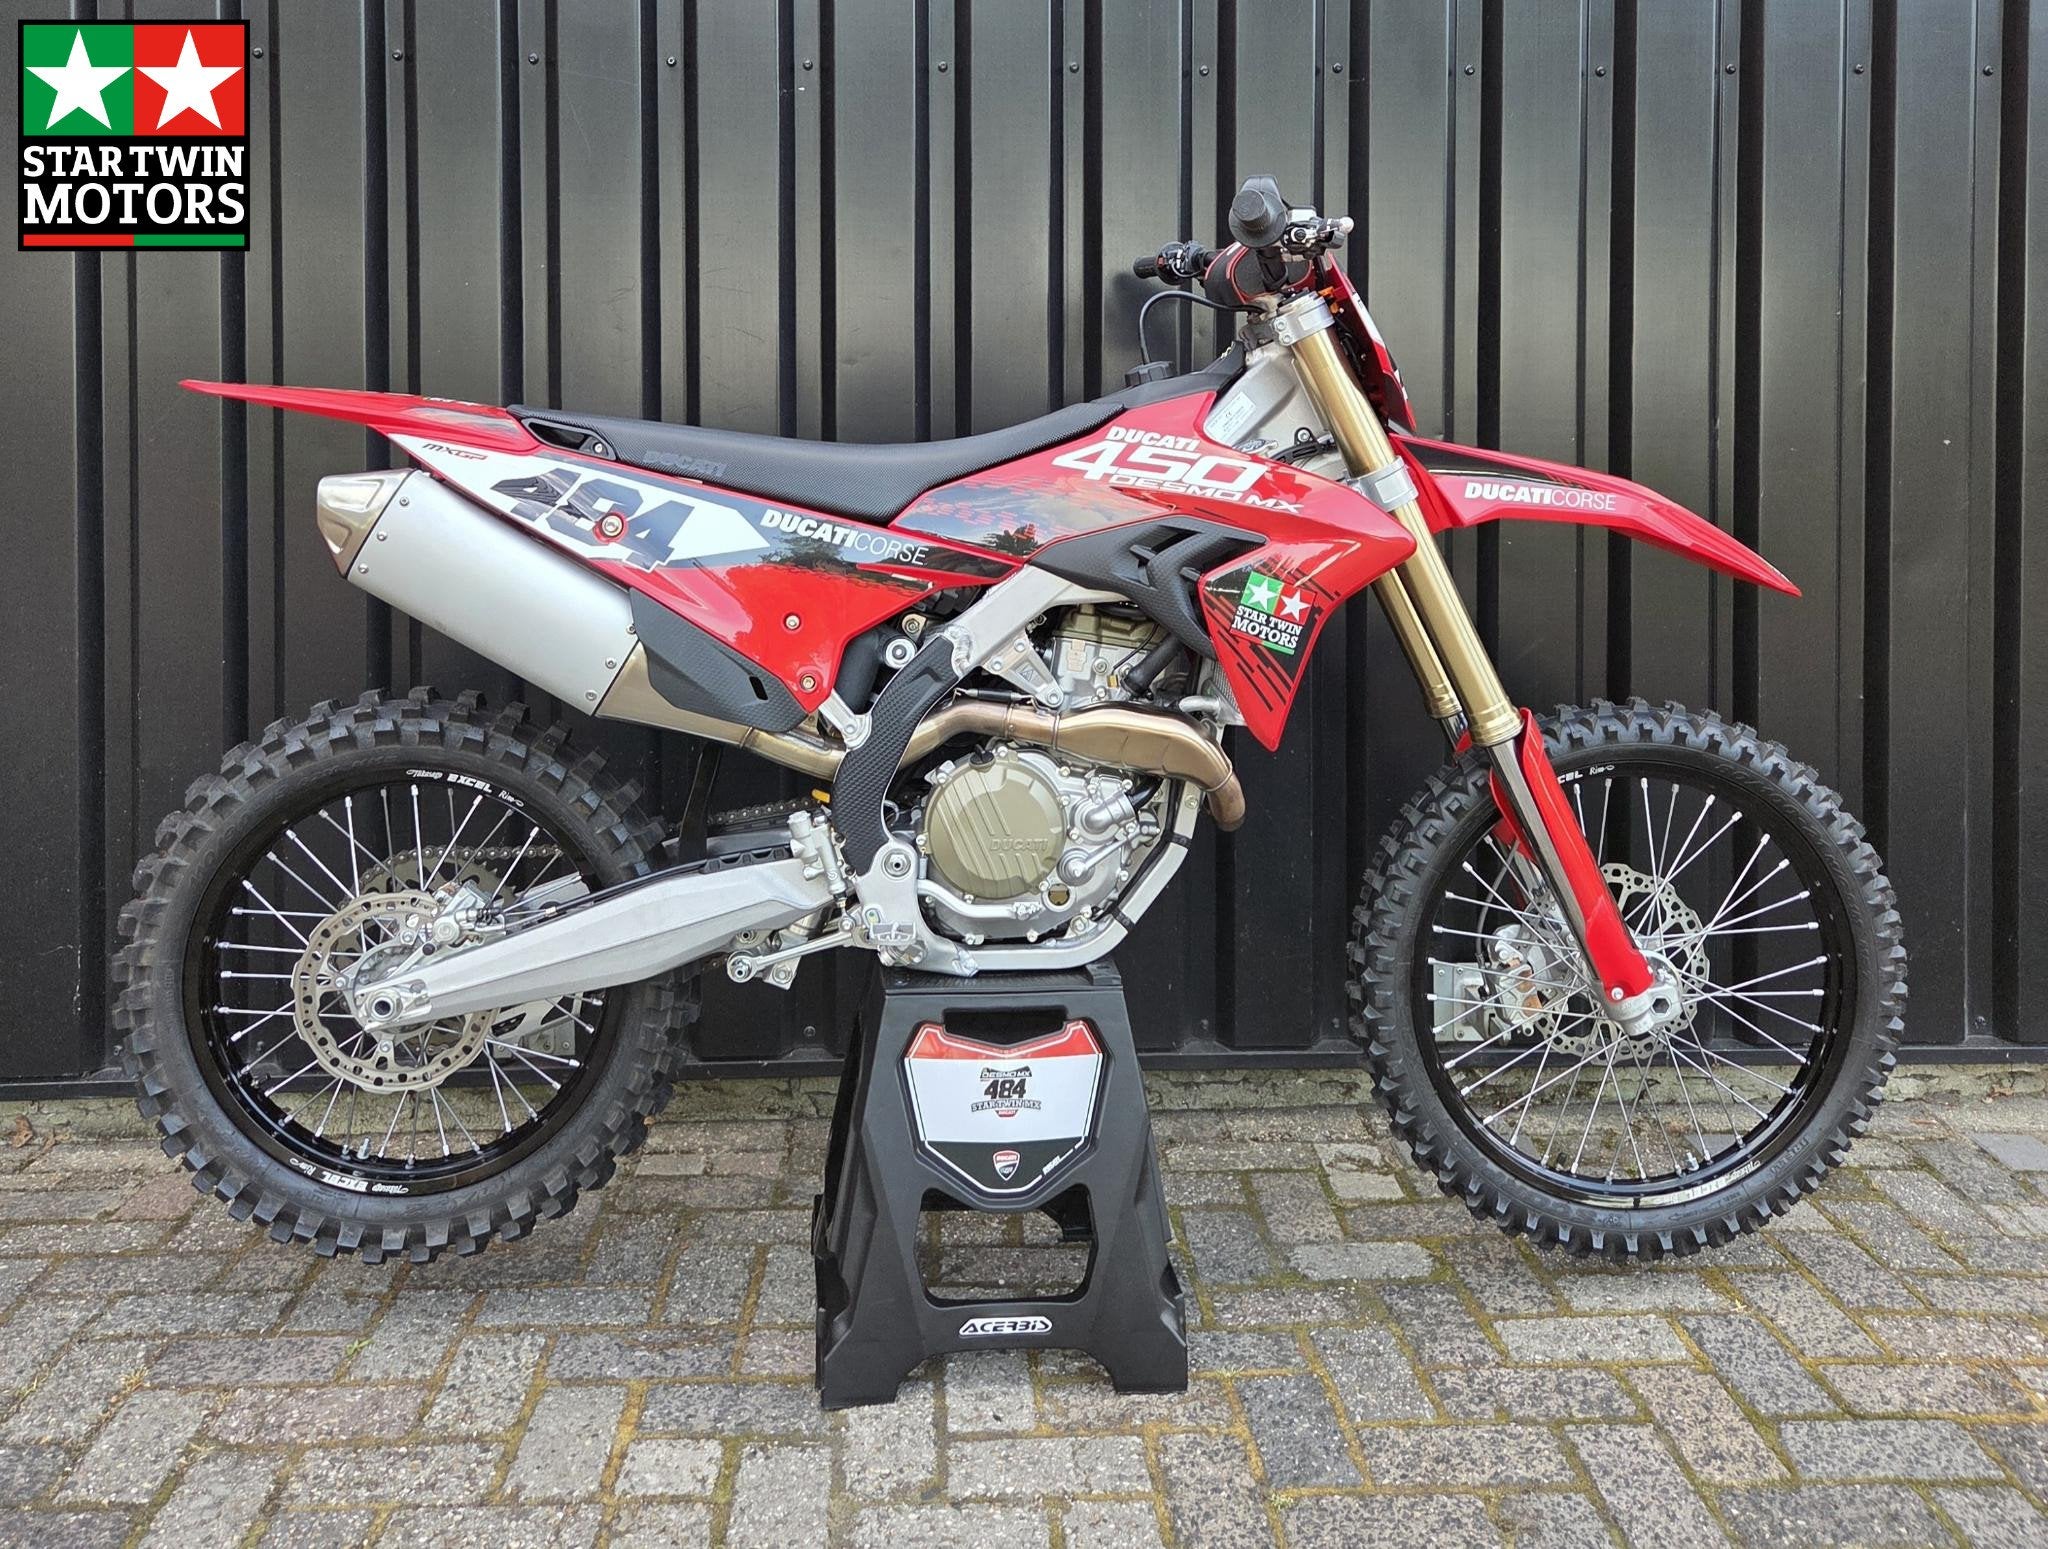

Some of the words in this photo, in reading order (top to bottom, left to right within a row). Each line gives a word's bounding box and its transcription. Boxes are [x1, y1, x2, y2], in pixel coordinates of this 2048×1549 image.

[421, 443, 489, 461] MXGP
[1104, 426, 1200, 452] DUCATI
[642, 450, 728, 477] DUCATI
[1051, 440, 1268, 493] 450
[1108, 474, 1243, 501] DESMO
[1245, 494, 1304, 514] MX
[490, 468, 695, 572] 484
[1231, 615, 1299, 649] MOTORS
[1236, 605, 1268, 625] STAR
[1269, 616, 1304, 636] TWIN
[447, 773, 493, 793] EXCEL
[1557, 770, 1584, 785] CEL
[990, 838, 1049, 851] DUCATI
[984, 1078, 1027, 1099] 484
[962, 1319, 1050, 1333] ACERBIS
